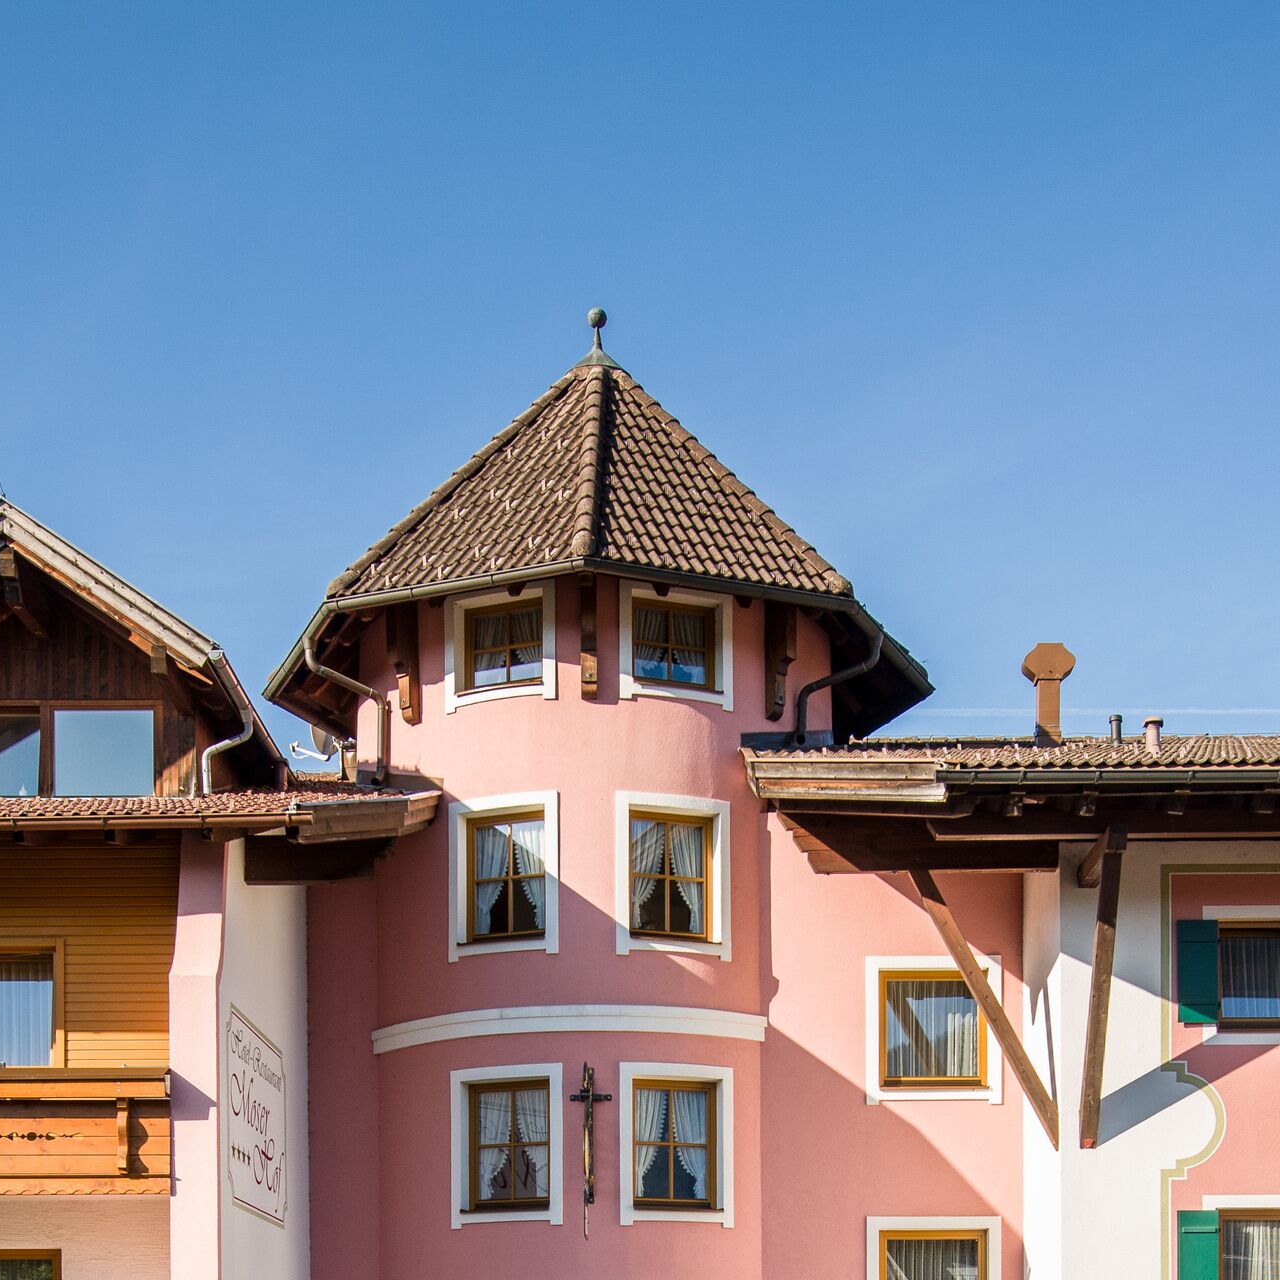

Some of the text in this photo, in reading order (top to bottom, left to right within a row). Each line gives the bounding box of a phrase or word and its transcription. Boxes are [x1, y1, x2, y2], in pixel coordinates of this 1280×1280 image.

[231, 1029, 281, 1093] Hotel-Restaurant
[230, 1069, 270, 1136] Moser
[253, 1139, 284, 1214] Hof
